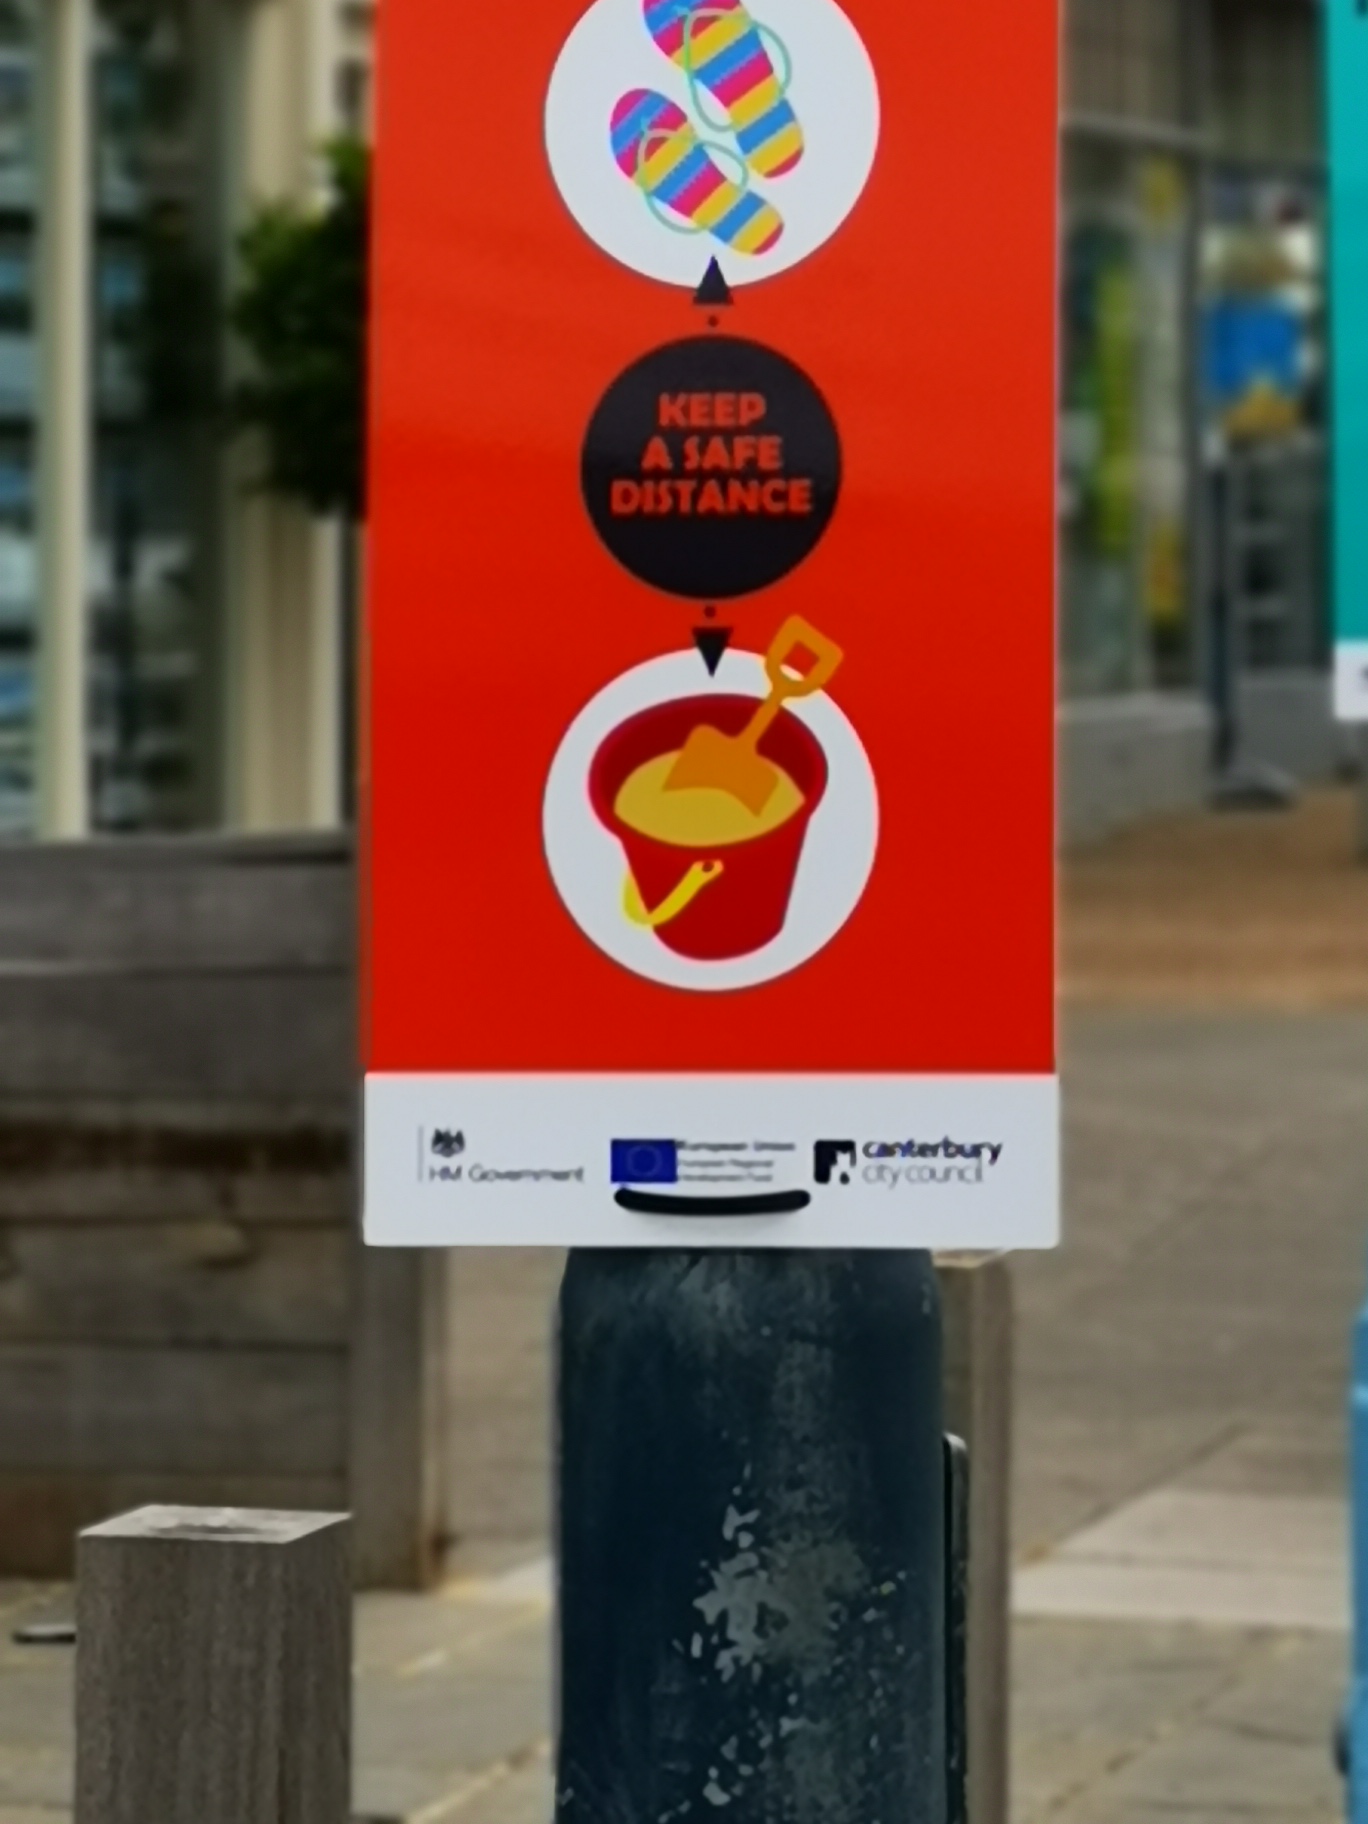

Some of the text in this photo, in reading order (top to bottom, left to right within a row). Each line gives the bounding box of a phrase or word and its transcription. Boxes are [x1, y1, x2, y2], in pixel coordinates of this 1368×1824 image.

[659, 392, 766, 427] KEEP
[641, 435, 783, 470] A SAFE
[611, 479, 812, 514] DISTANCE
[862, 1136, 1002, 1165] canterbury
[468, 1163, 585, 1183] Government
[862, 1154, 984, 1189] city council
